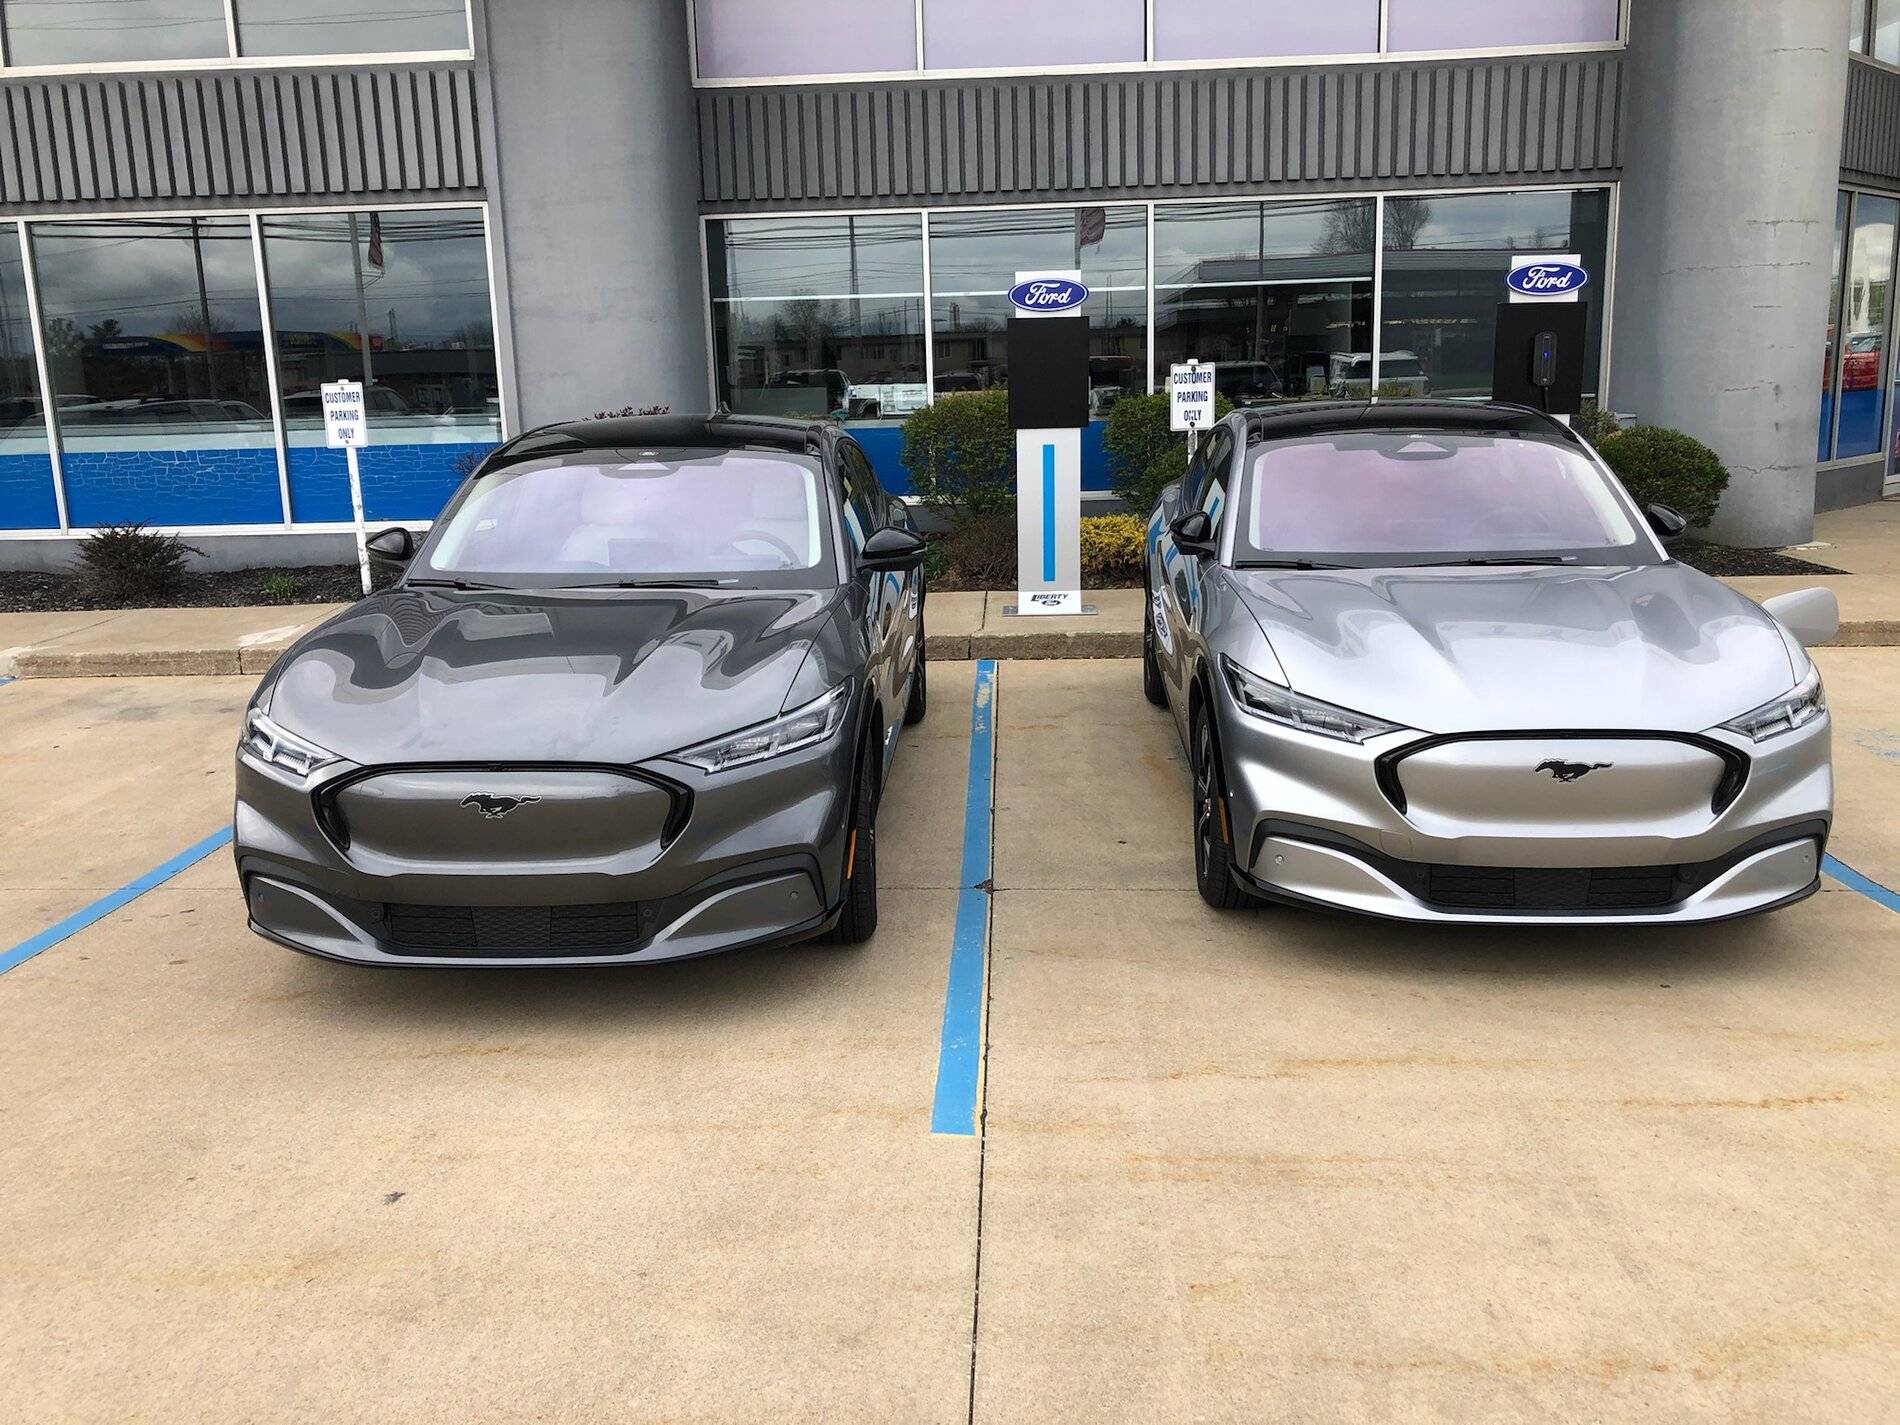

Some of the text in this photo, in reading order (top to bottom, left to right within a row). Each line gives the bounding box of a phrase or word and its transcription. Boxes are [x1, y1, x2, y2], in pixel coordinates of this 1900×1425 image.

[1523, 266, 1573, 289] Ford
[1024, 282, 1072, 305] Ford
[1173, 371, 1212, 384] CUSTOMER
[325, 391, 361, 404] CUSTOMER
[1177, 390, 1208, 403] PARKING
[330, 409, 359, 421] PARKING
[1183, 409, 1202, 422] ONLY
[338, 428, 354, 439] ONLY
[1031, 593, 1069, 602] LIBERTY
